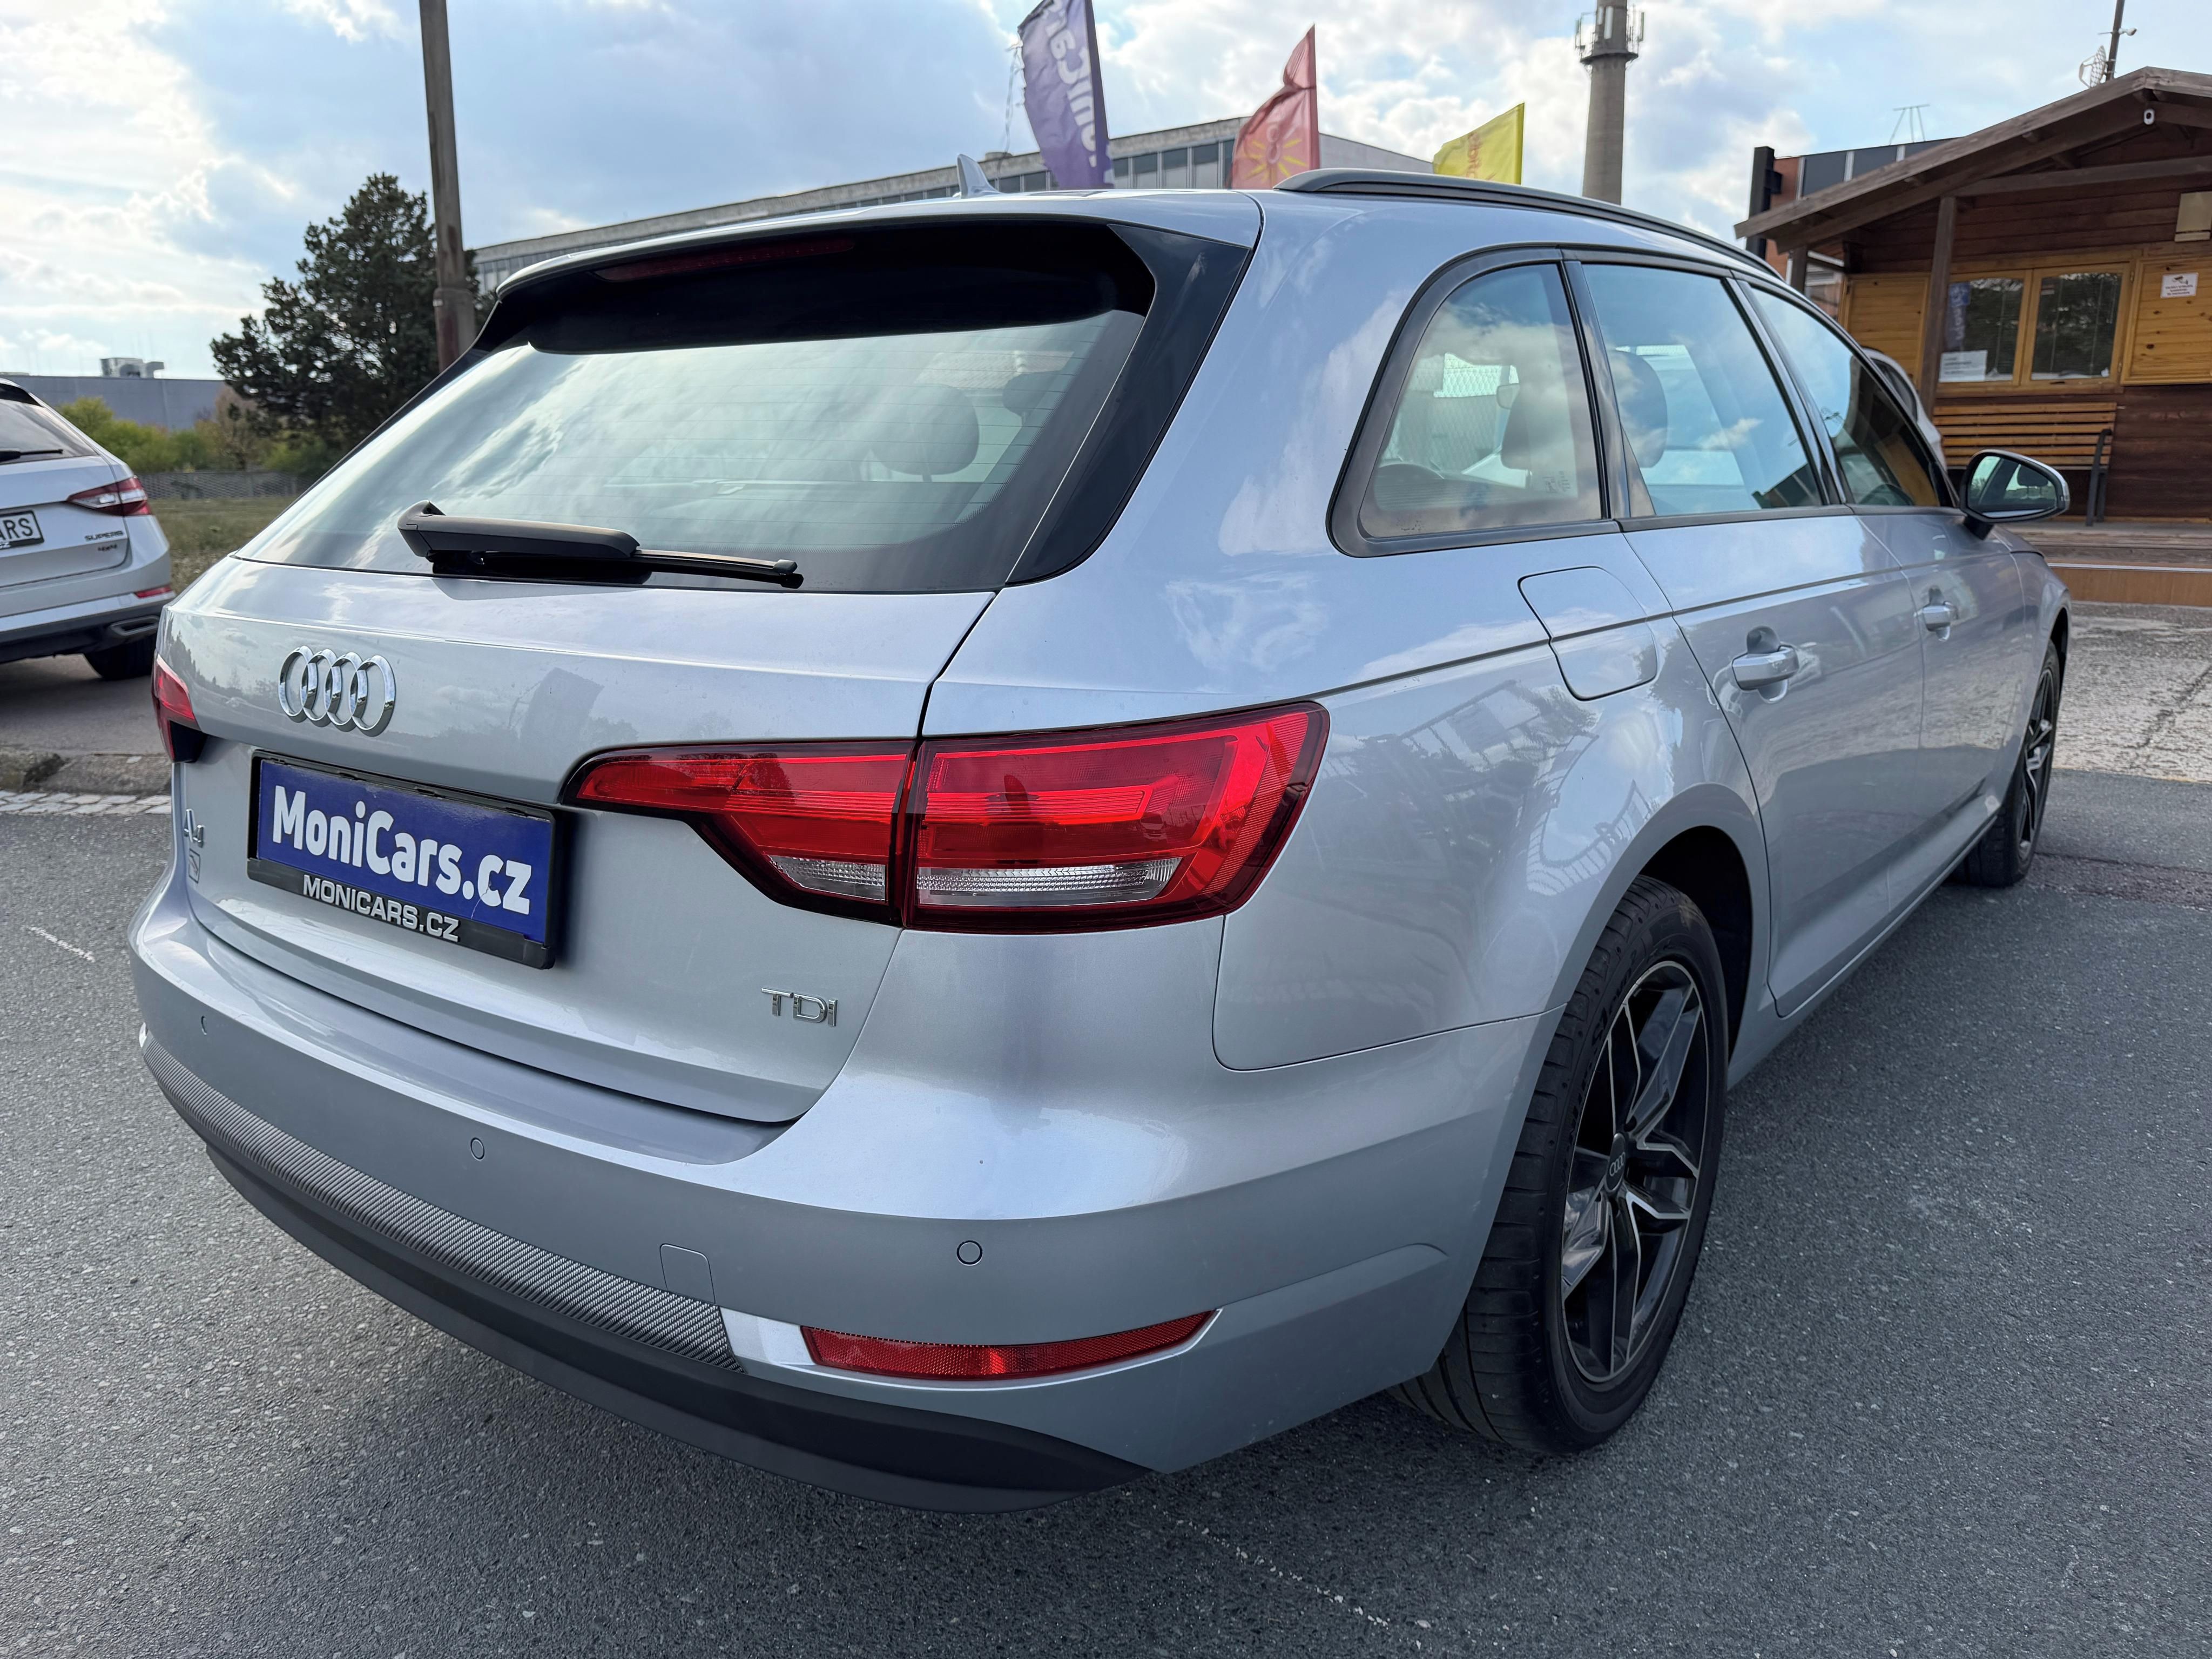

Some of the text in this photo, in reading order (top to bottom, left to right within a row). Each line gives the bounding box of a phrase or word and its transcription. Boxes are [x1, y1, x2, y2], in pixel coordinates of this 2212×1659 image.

[272, 785, 532, 916] MoniCars.cz
[303, 874, 461, 942] MONICARS.CZ
[761, 986, 838, 1027] TDI
